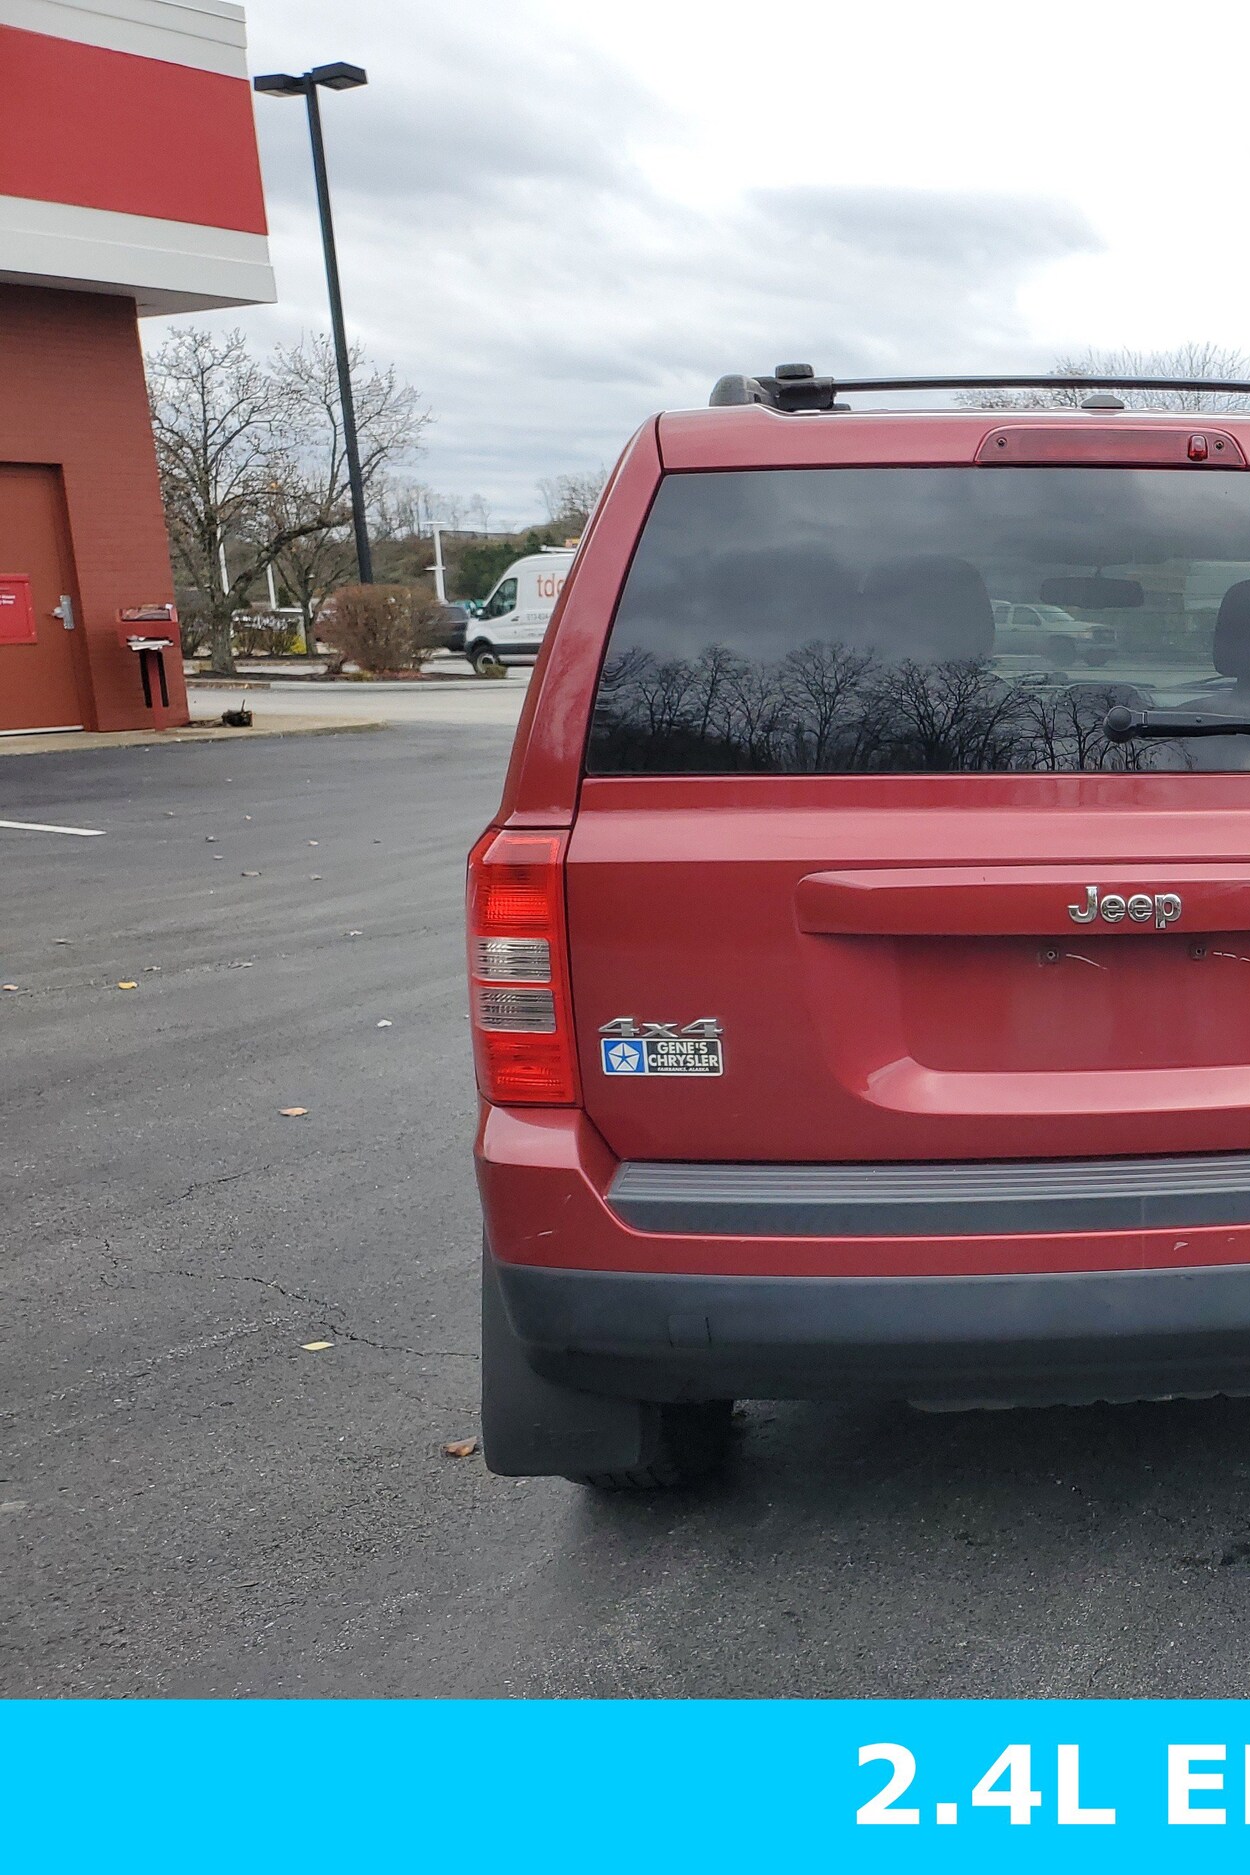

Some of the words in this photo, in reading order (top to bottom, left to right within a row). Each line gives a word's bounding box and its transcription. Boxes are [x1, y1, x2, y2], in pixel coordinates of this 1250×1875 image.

[1067, 886, 1182, 929] Jeep
[598, 1018, 724, 1038] 4x4
[657, 1042, 708, 1054] GENE'S
[648, 1054, 719, 1067] CHRYSLER
